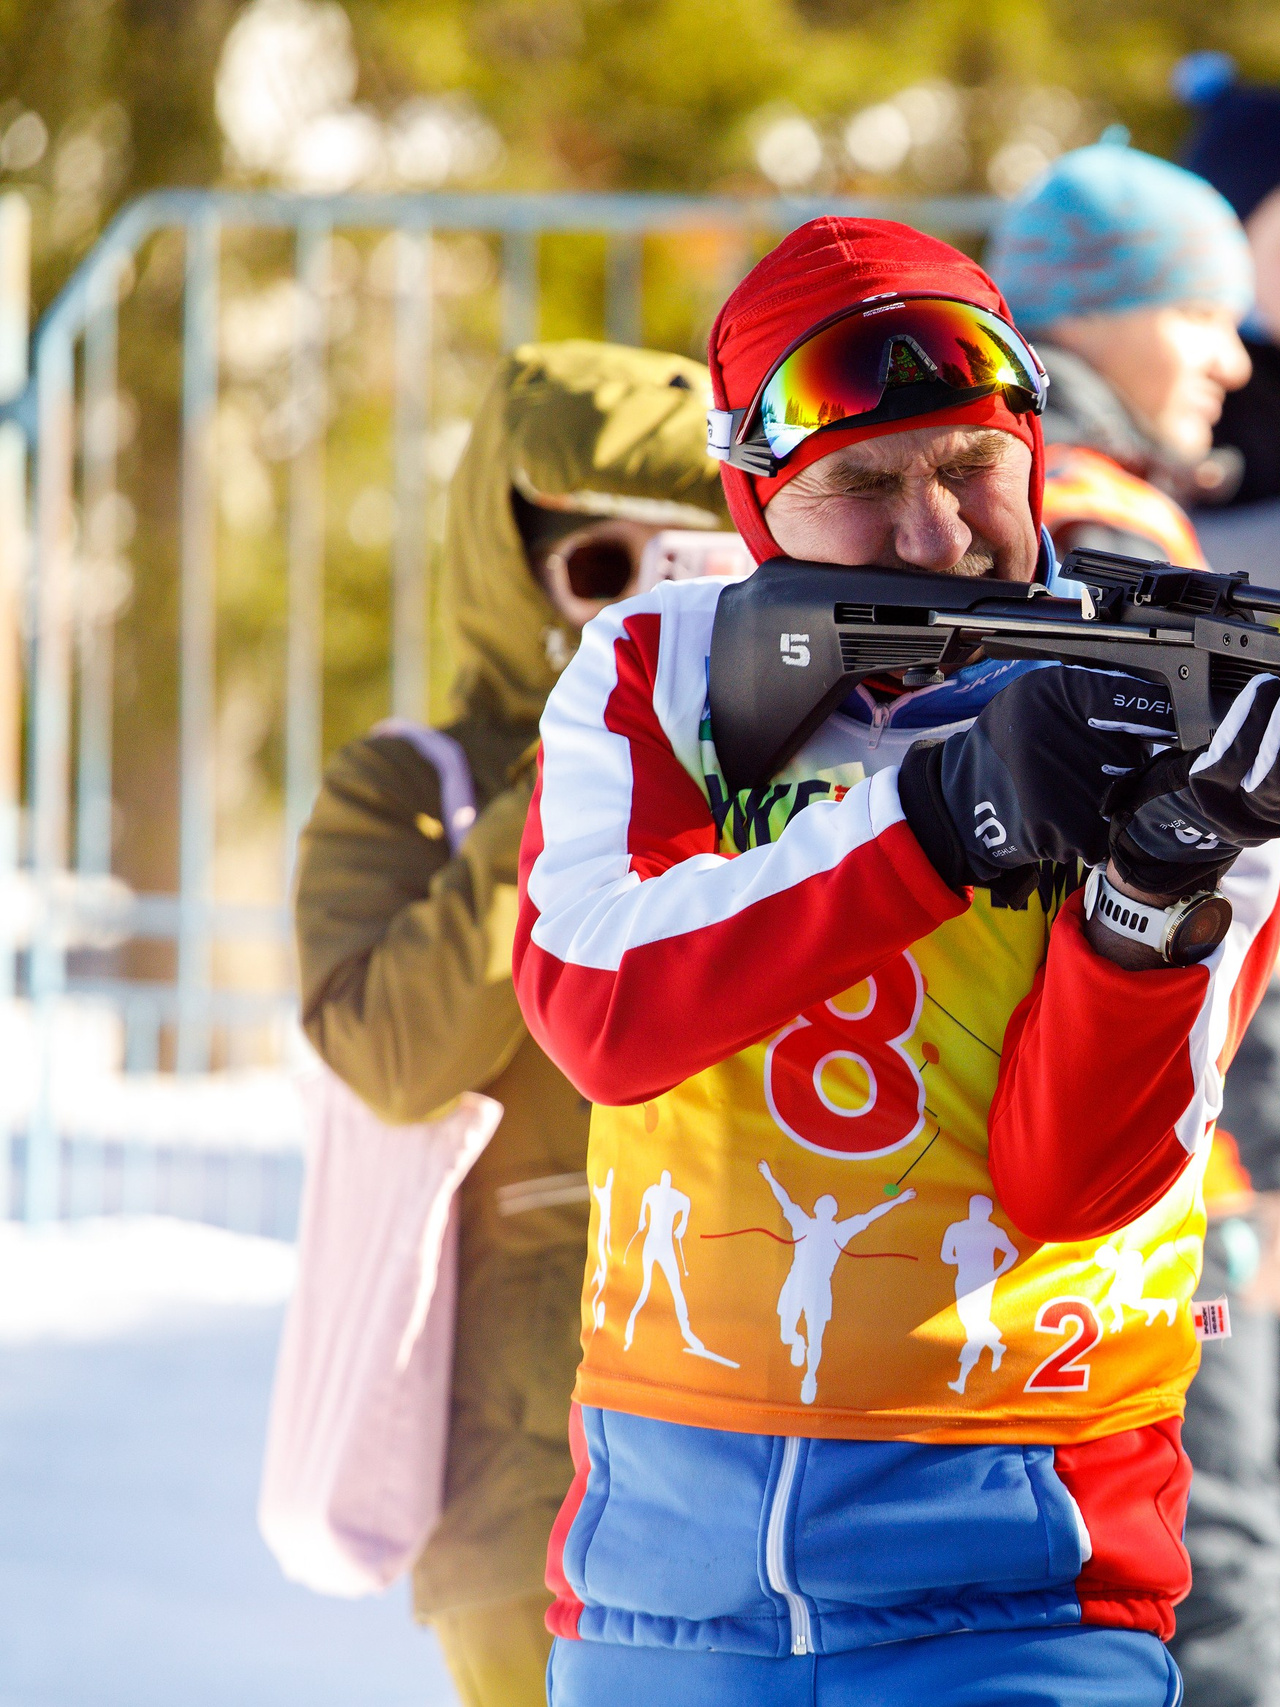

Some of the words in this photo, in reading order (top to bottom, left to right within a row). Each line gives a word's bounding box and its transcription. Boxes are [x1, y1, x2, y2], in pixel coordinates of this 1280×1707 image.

[780, 633, 811, 667] 5
[764, 949, 926, 1161] 8
[1023, 1295, 1104, 1393] 2
